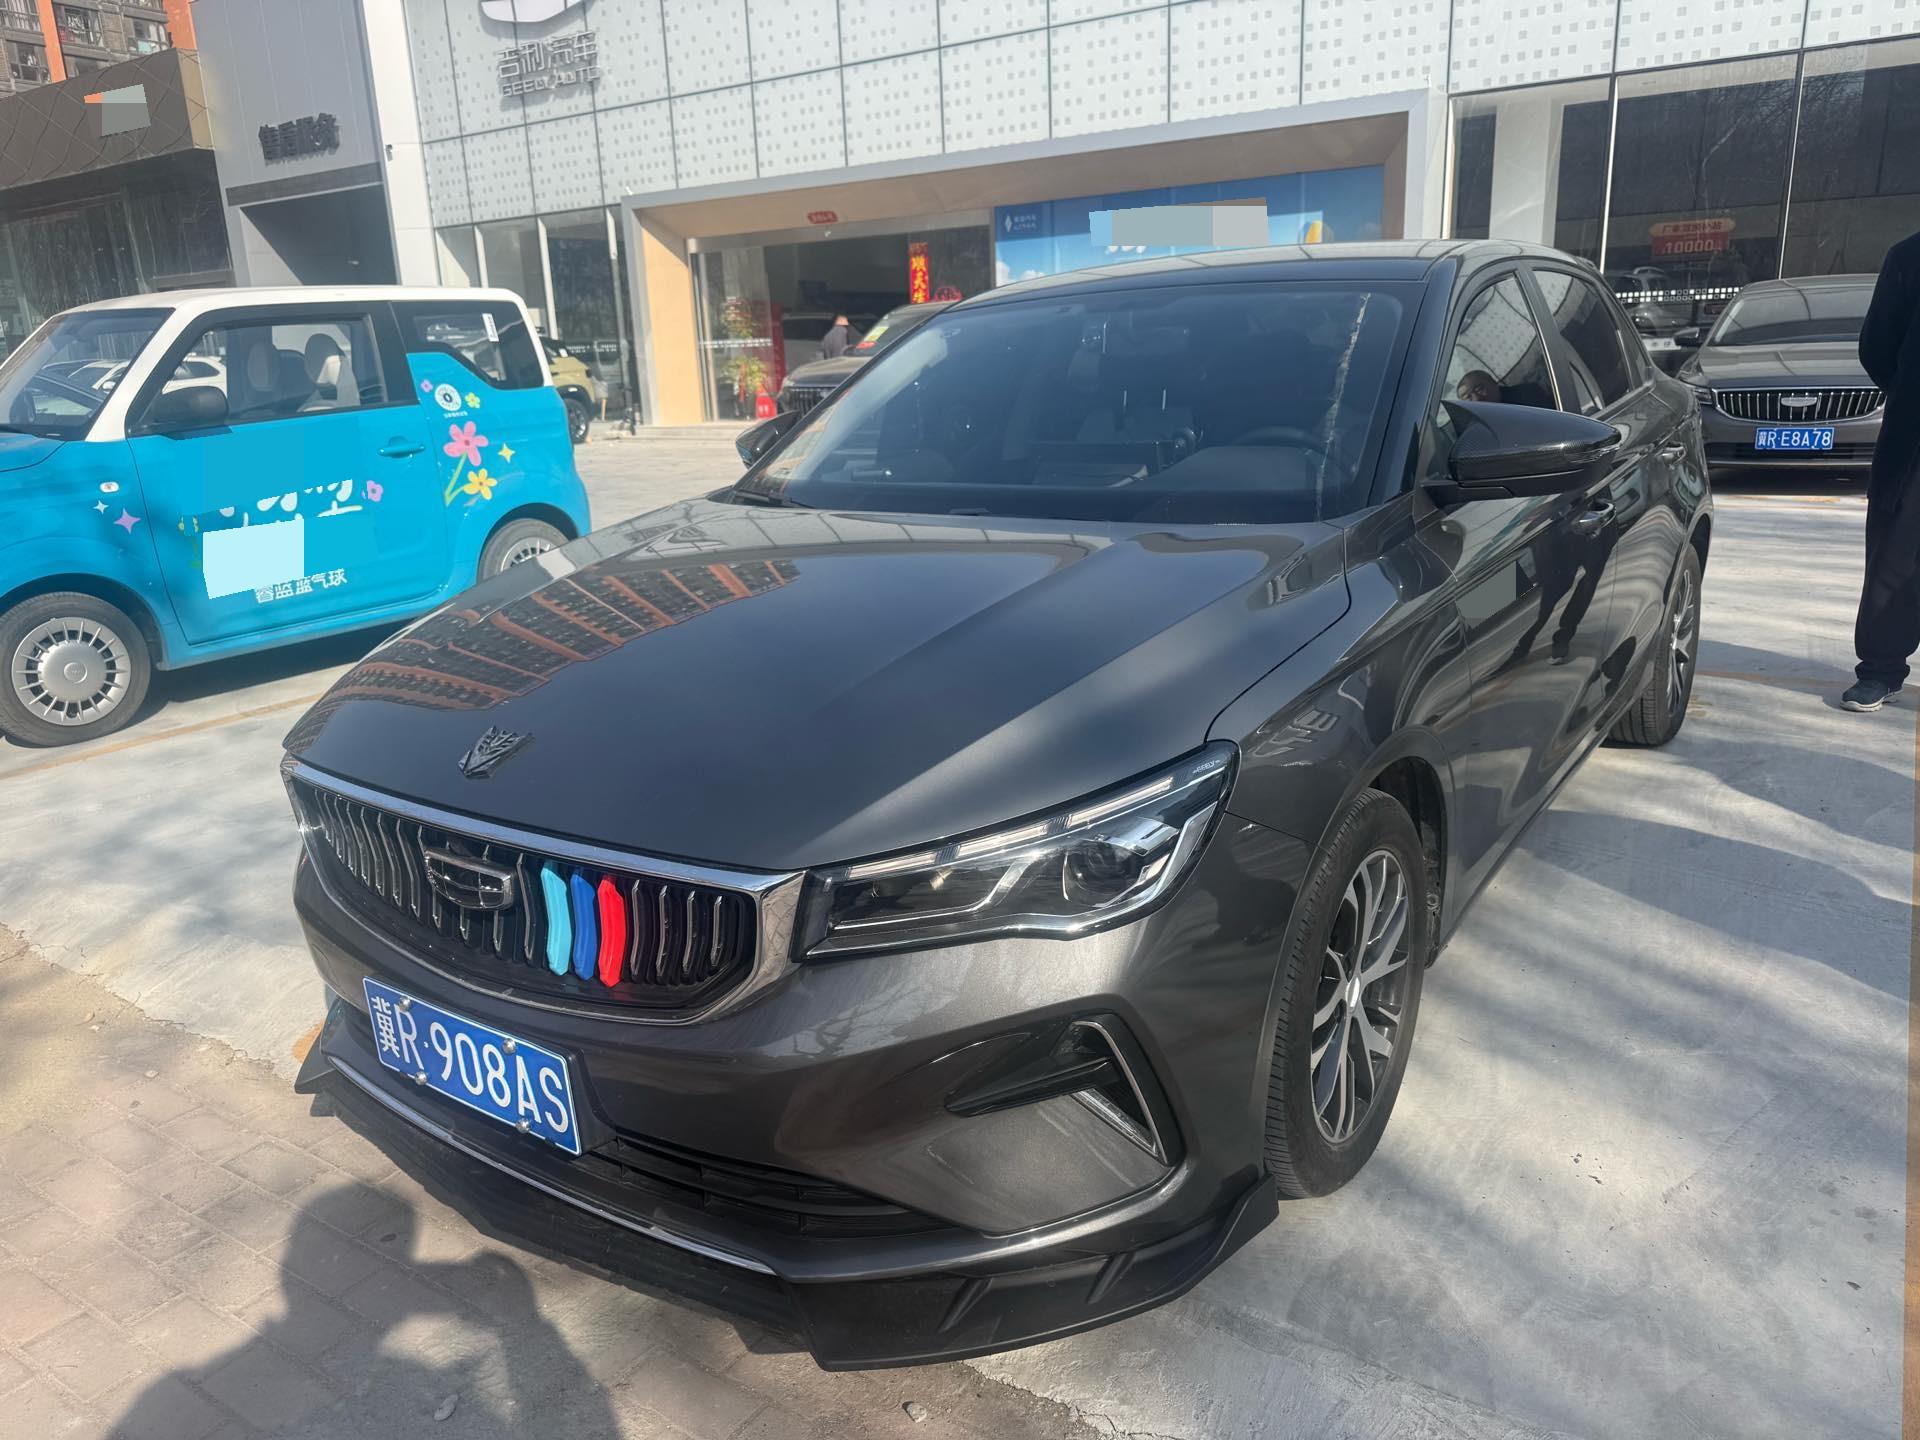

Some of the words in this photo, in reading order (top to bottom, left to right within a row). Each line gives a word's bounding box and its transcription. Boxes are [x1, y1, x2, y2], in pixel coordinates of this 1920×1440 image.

[496, 30, 598, 78] 吉利汽车
[556, 65, 601, 86] AUTO
[370, 995, 570, 1134] 冀R·908AS
